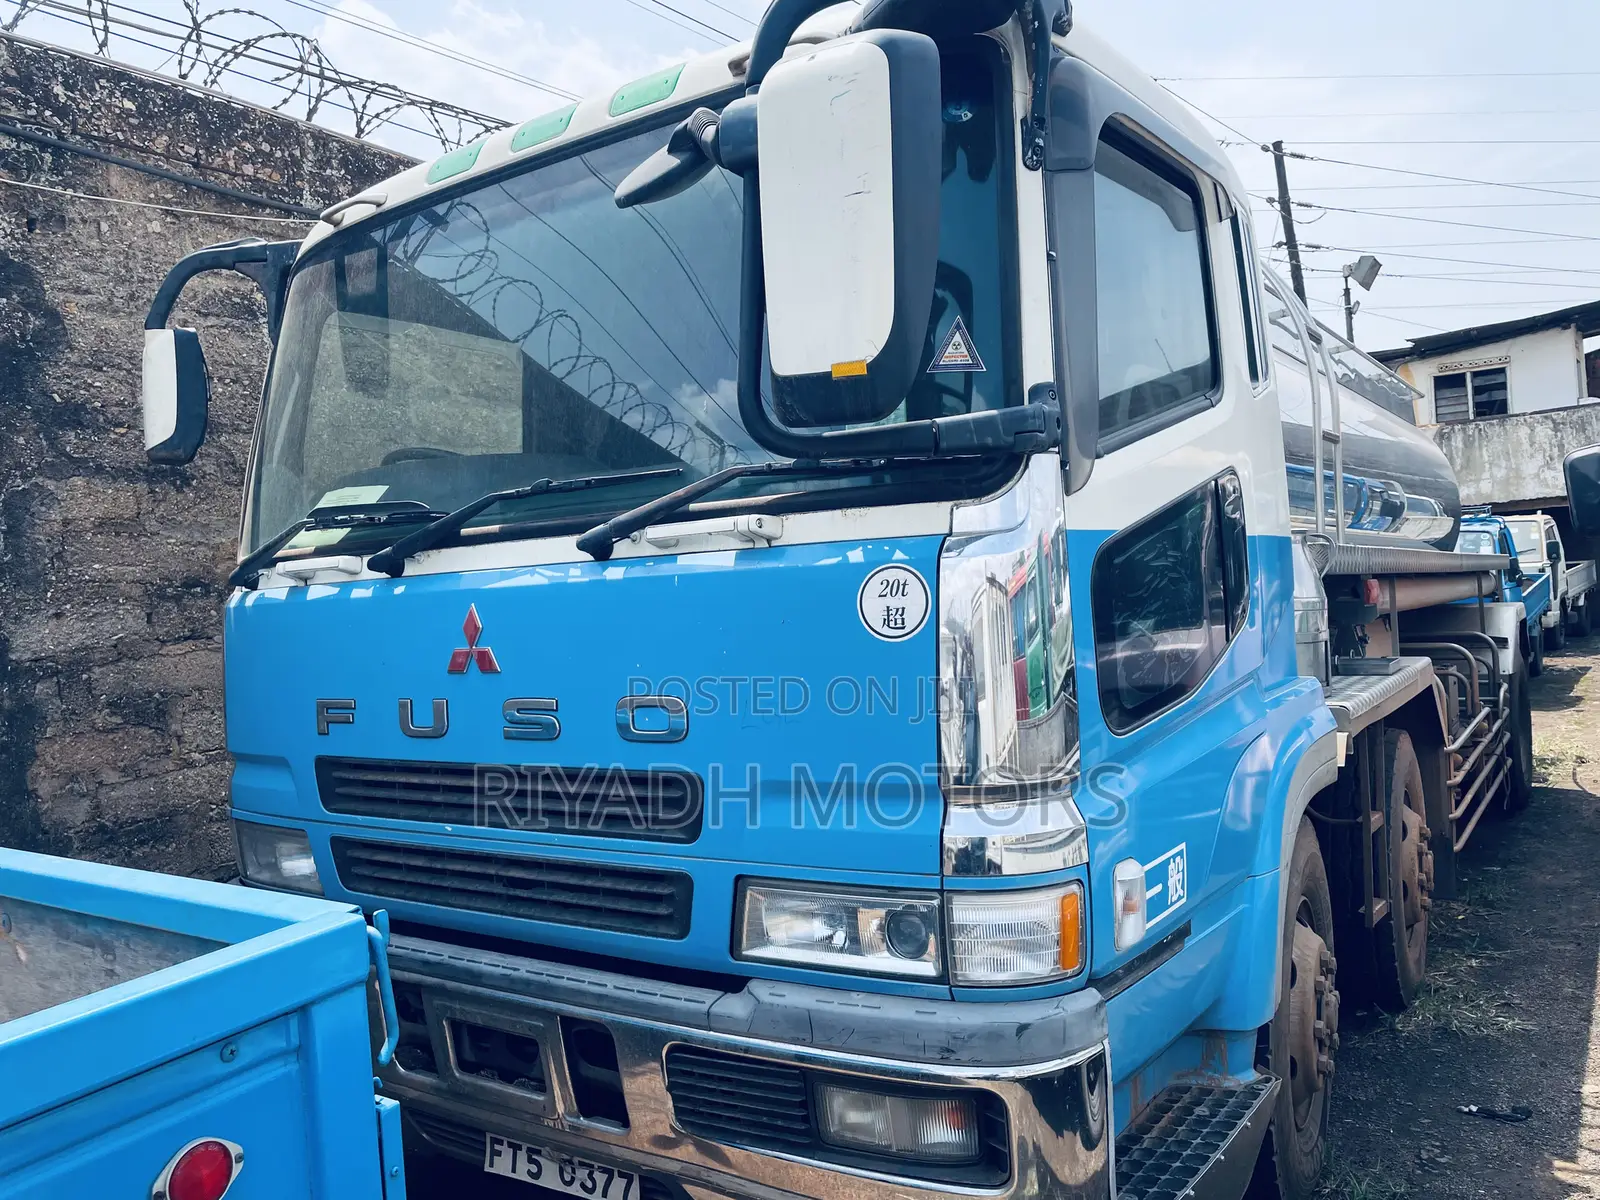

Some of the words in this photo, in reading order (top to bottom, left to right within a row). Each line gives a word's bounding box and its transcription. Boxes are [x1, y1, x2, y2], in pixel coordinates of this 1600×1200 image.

[878, 577, 909, 598] 20t
[881, 605, 907, 630] 超
[315, 695, 689, 743] FUSO
